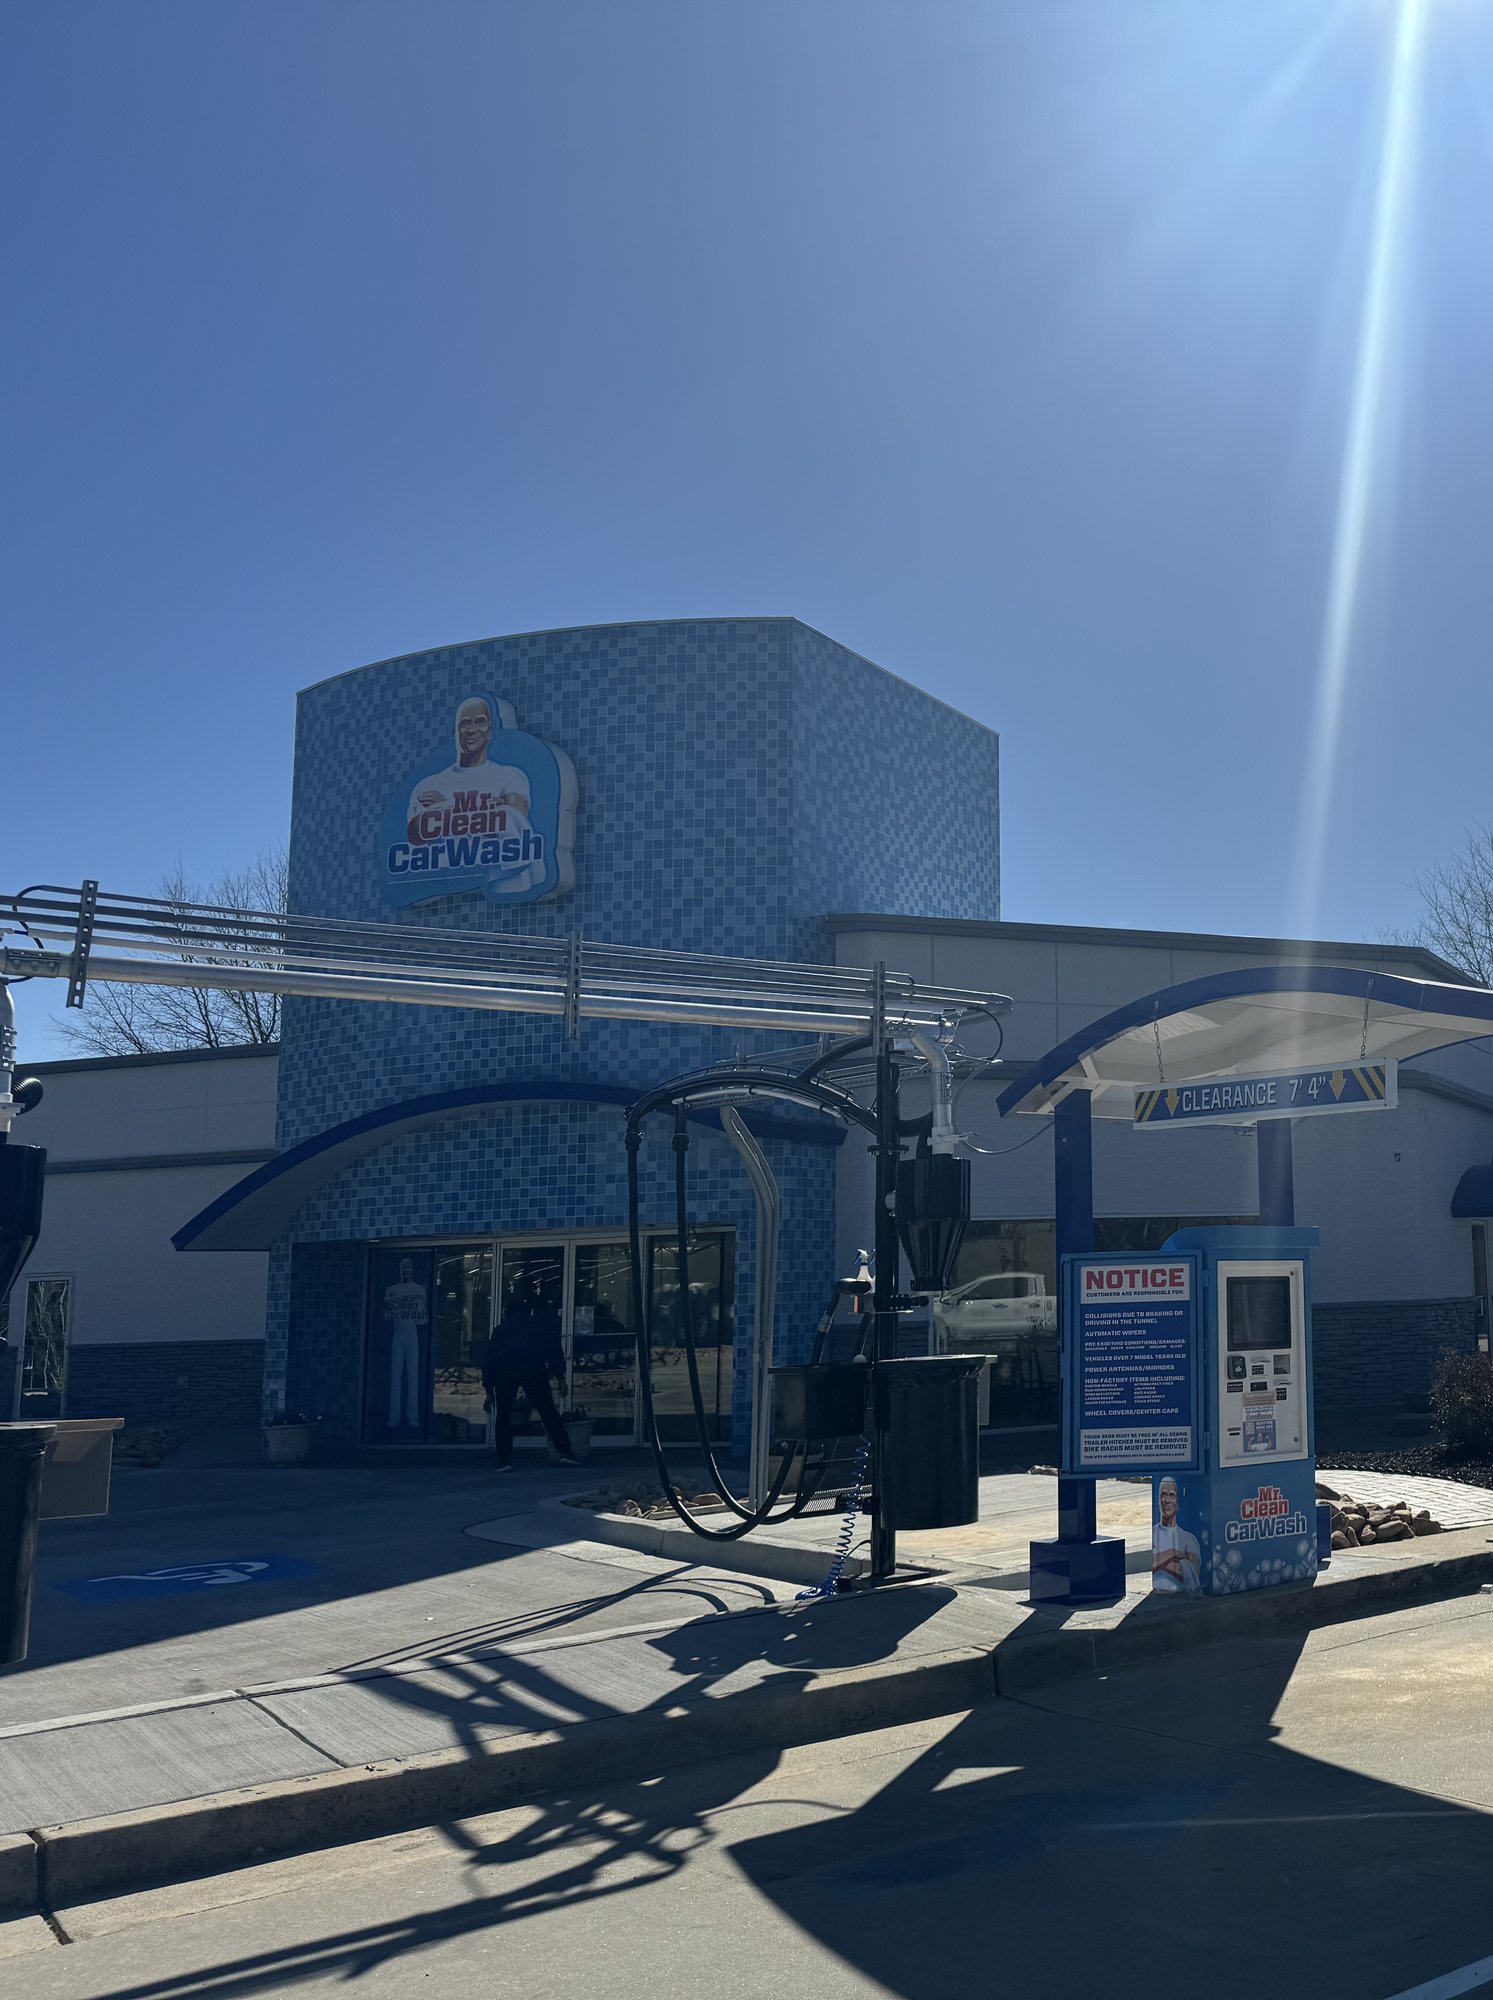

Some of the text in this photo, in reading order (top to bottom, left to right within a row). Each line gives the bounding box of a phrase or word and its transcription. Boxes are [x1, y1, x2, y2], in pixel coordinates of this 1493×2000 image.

[452, 789, 495, 814] Mr.
[420, 809, 507, 840] Clean
[388, 829, 544, 873] CarWash
[1182, 1082, 1276, 1112] CLEARANCE
[1086, 1268, 1184, 1289] NOTICE
[1258, 1486, 1282, 1502] Mr.
[1241, 1498, 1289, 1520] Clean
[1225, 1512, 1306, 1543] CarWash
